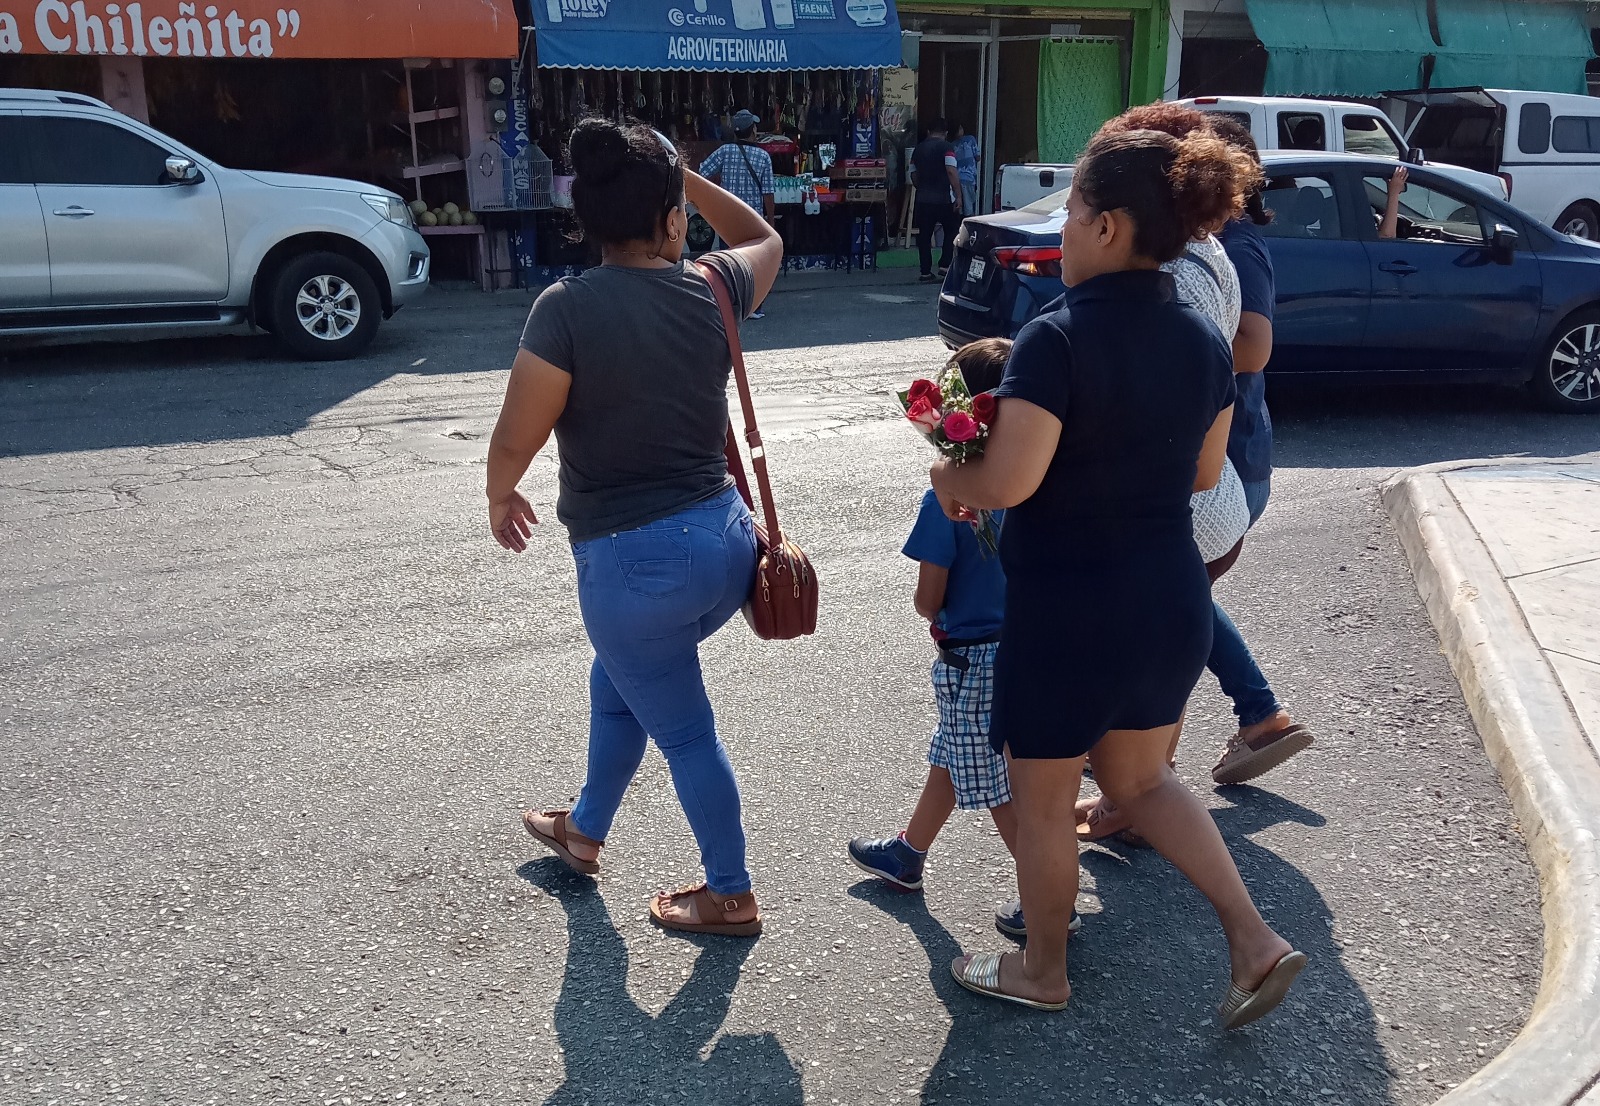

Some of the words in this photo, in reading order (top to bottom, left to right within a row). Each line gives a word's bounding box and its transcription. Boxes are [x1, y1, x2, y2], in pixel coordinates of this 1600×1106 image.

[800, 4, 829, 14] FAENA
[686, 13, 726, 26] Cerillo
[668, 36, 788, 62] AGROVETERINARIA
